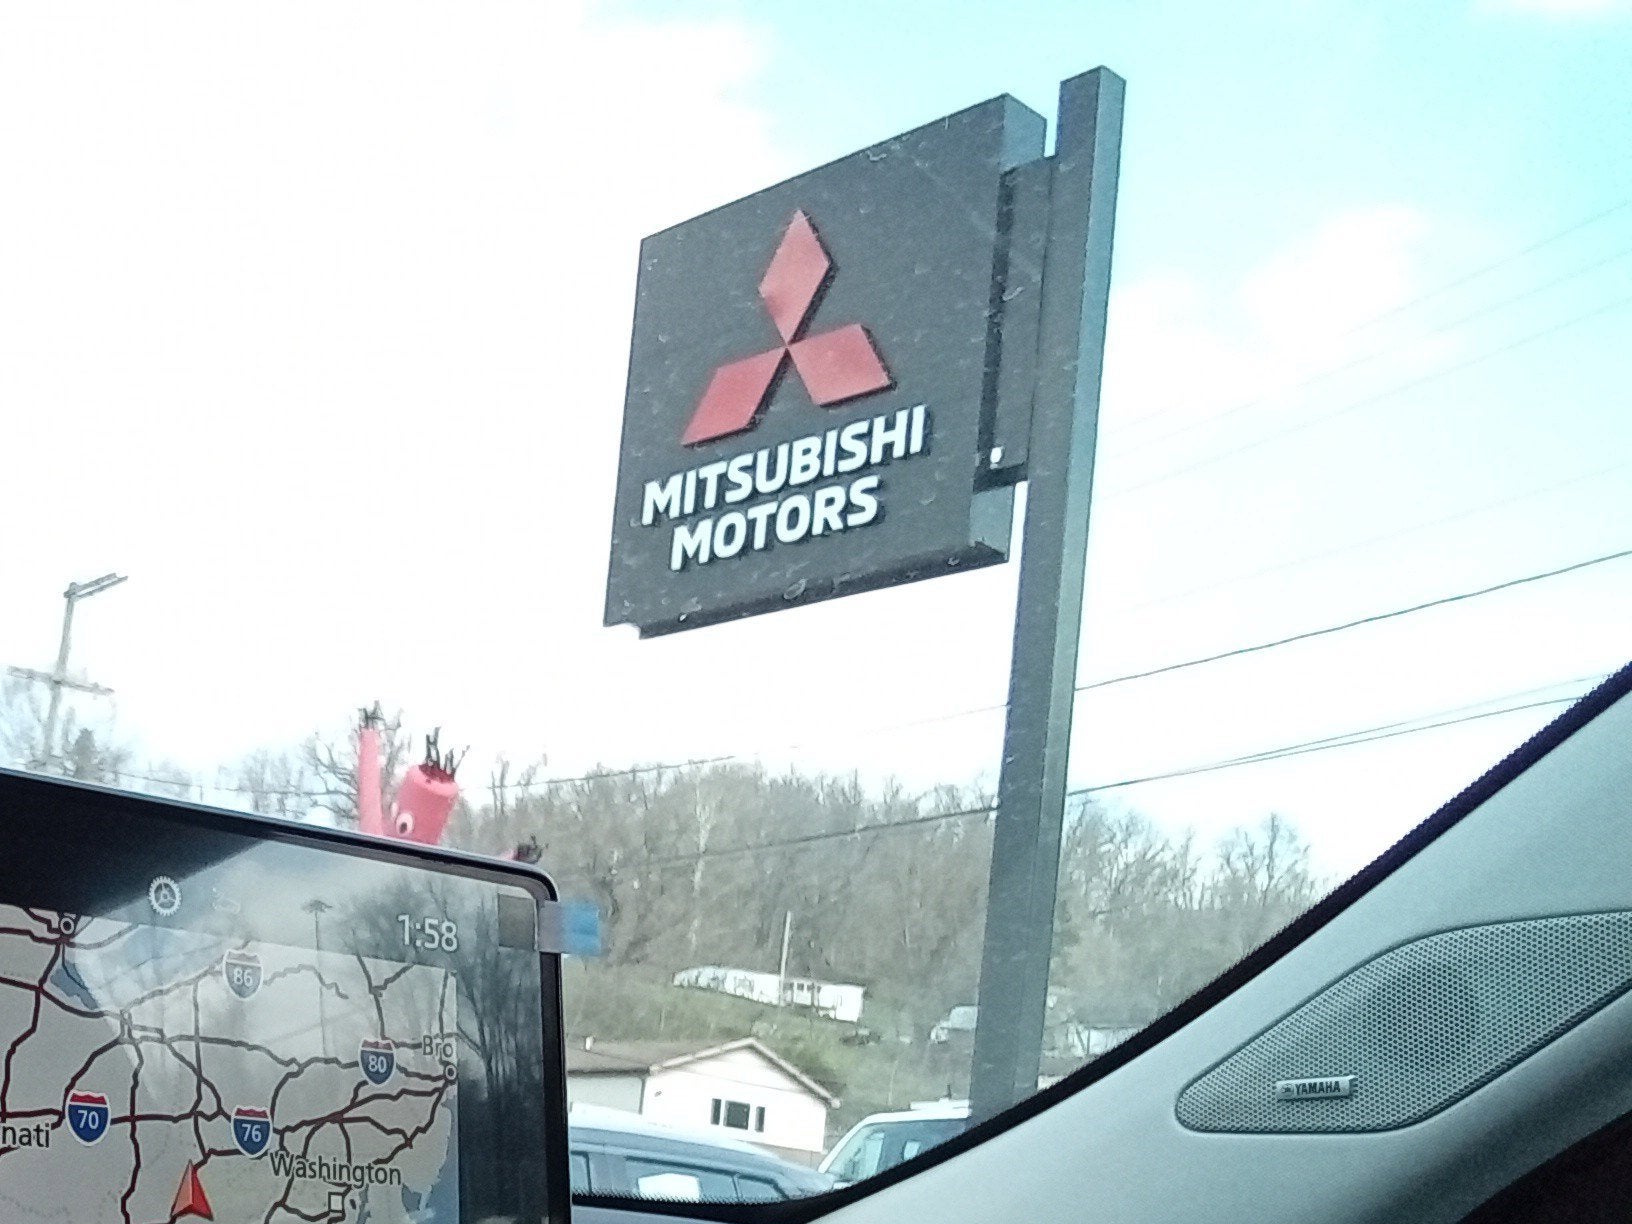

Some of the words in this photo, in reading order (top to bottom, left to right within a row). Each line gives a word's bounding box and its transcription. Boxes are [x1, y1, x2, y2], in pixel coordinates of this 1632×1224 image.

[641, 404, 926, 526] MITSUBISHI
[670, 475, 880, 572] MOTORS
[397, 914, 458, 952] 1:58
[367, 1054, 388, 1074] 80
[1294, 1080, 1341, 1096] YAMAHA
[77, 1109, 99, 1130] 70
[241, 1123, 262, 1143] 76
[270, 1152, 402, 1188] Washington
